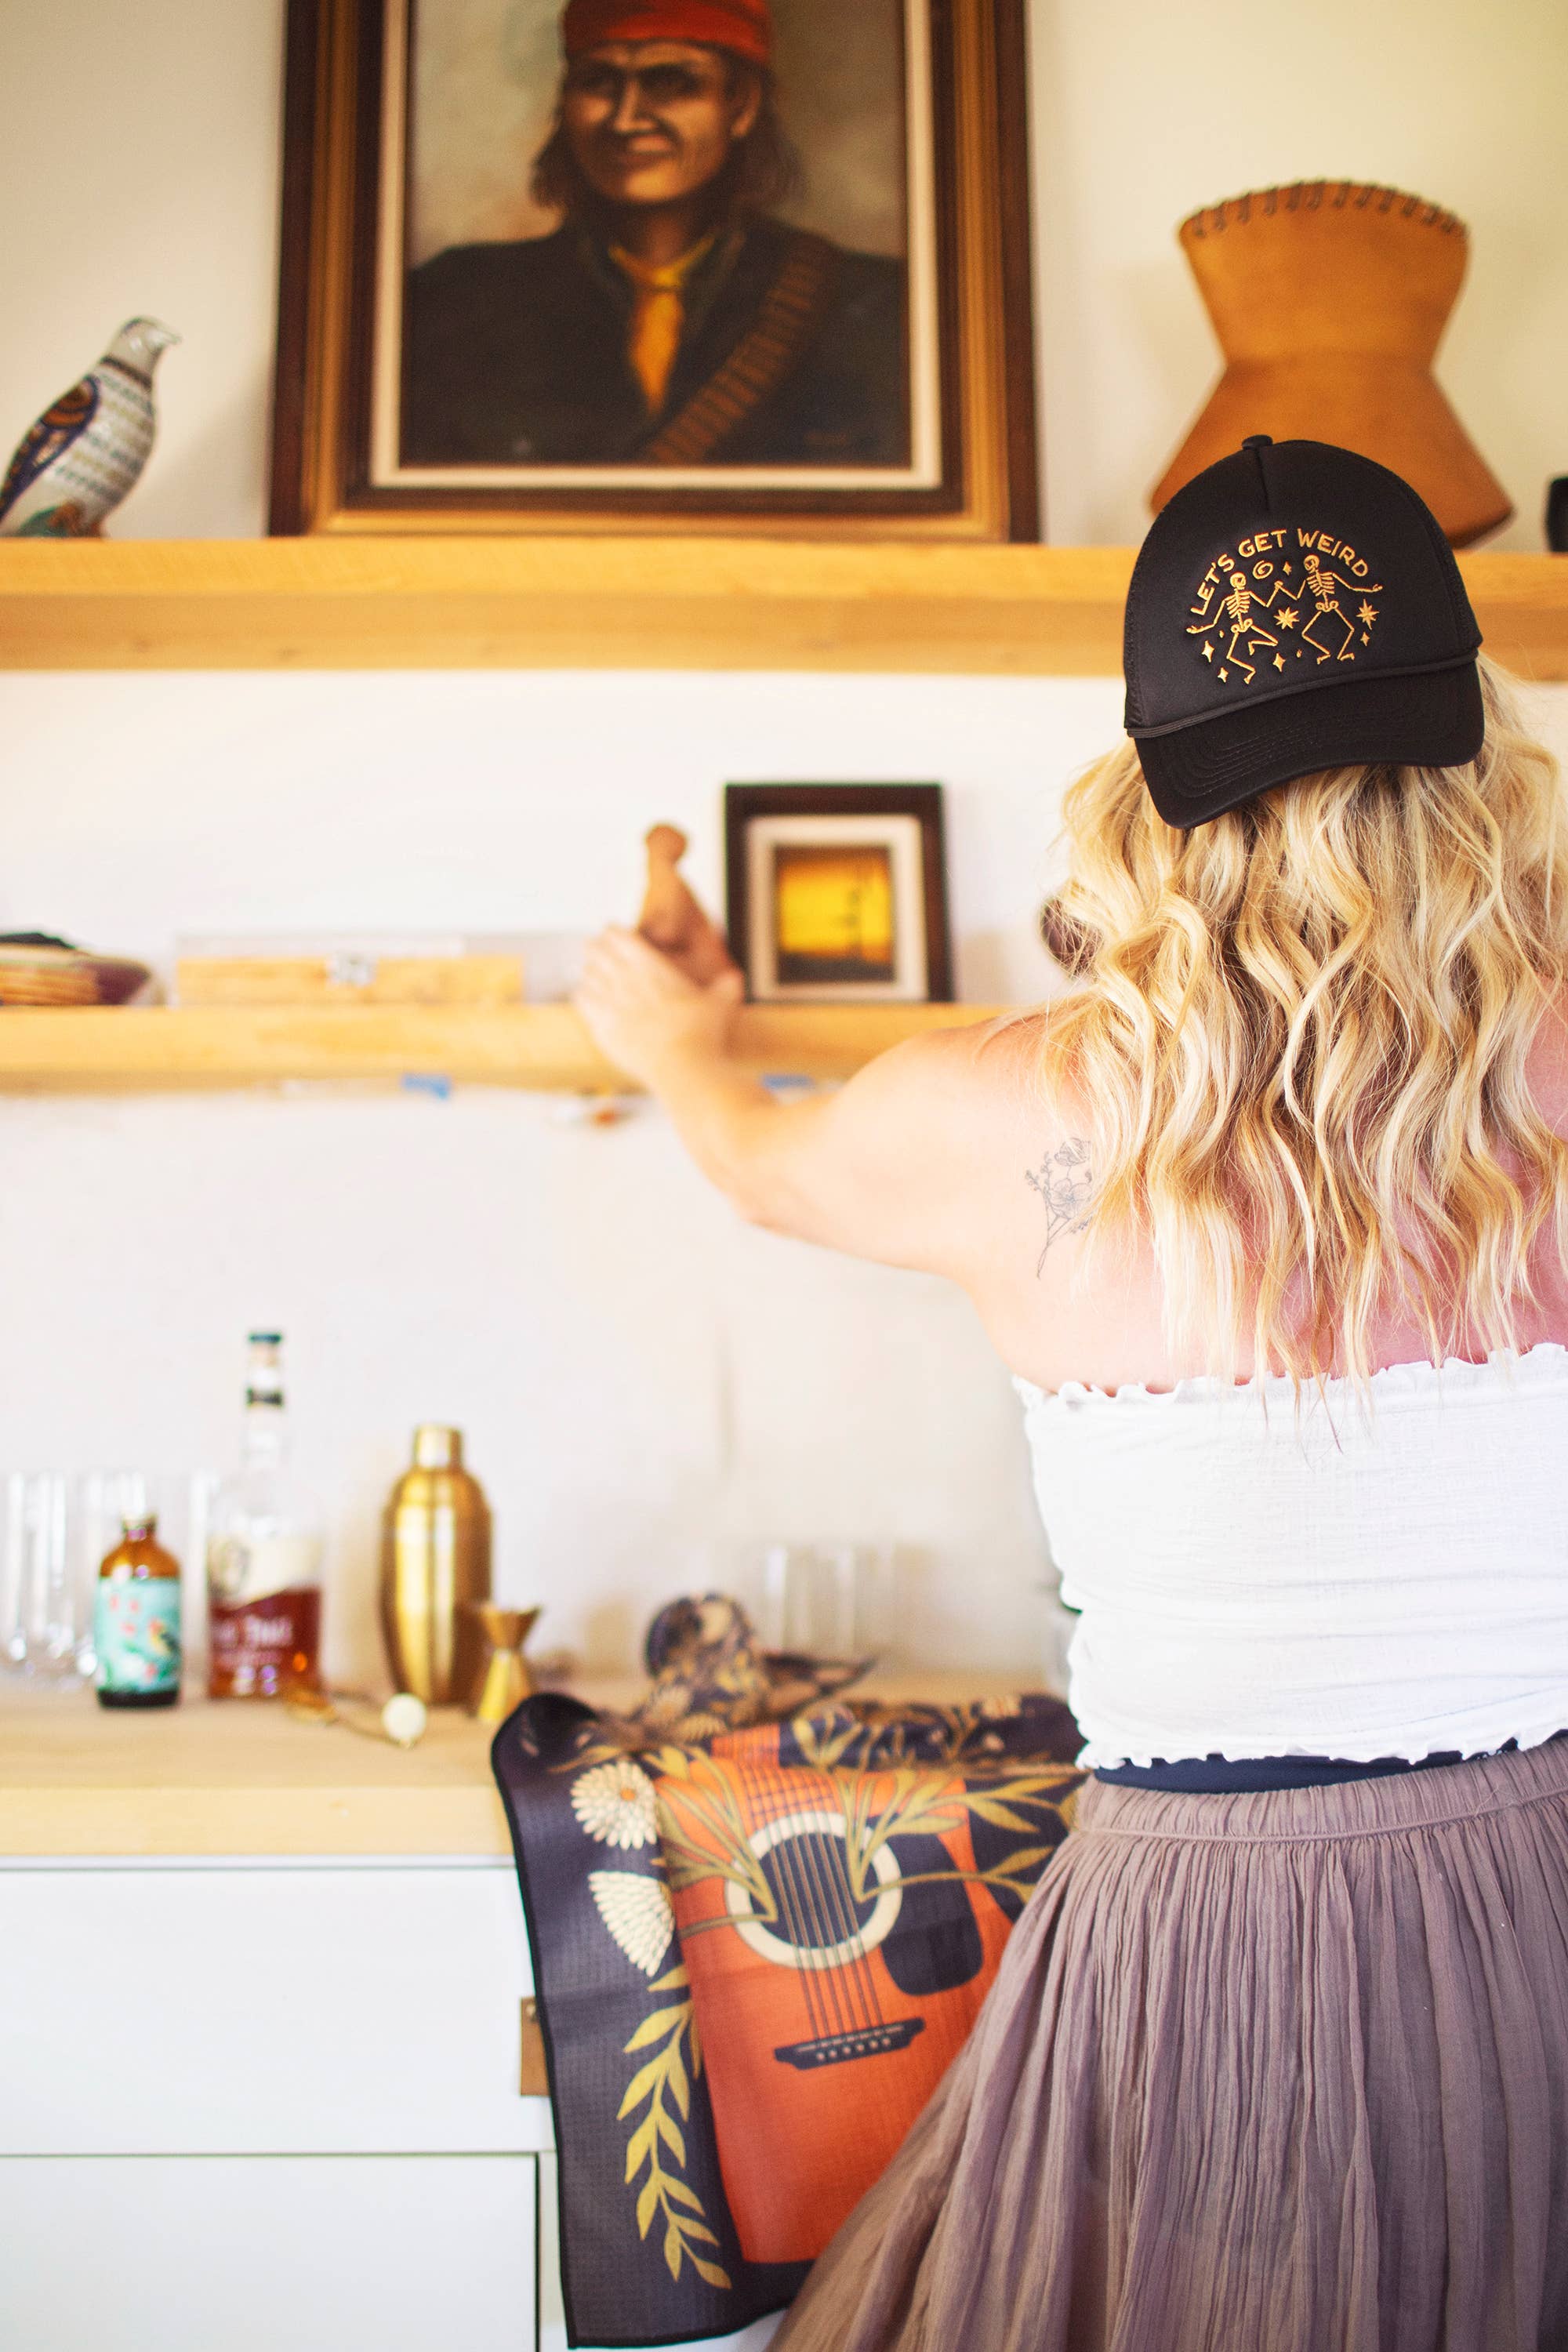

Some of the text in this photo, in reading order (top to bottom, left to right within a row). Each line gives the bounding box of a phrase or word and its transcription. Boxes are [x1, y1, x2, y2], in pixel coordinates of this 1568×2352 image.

[1190, 528, 1369, 615] LET'S GET WEIRD
